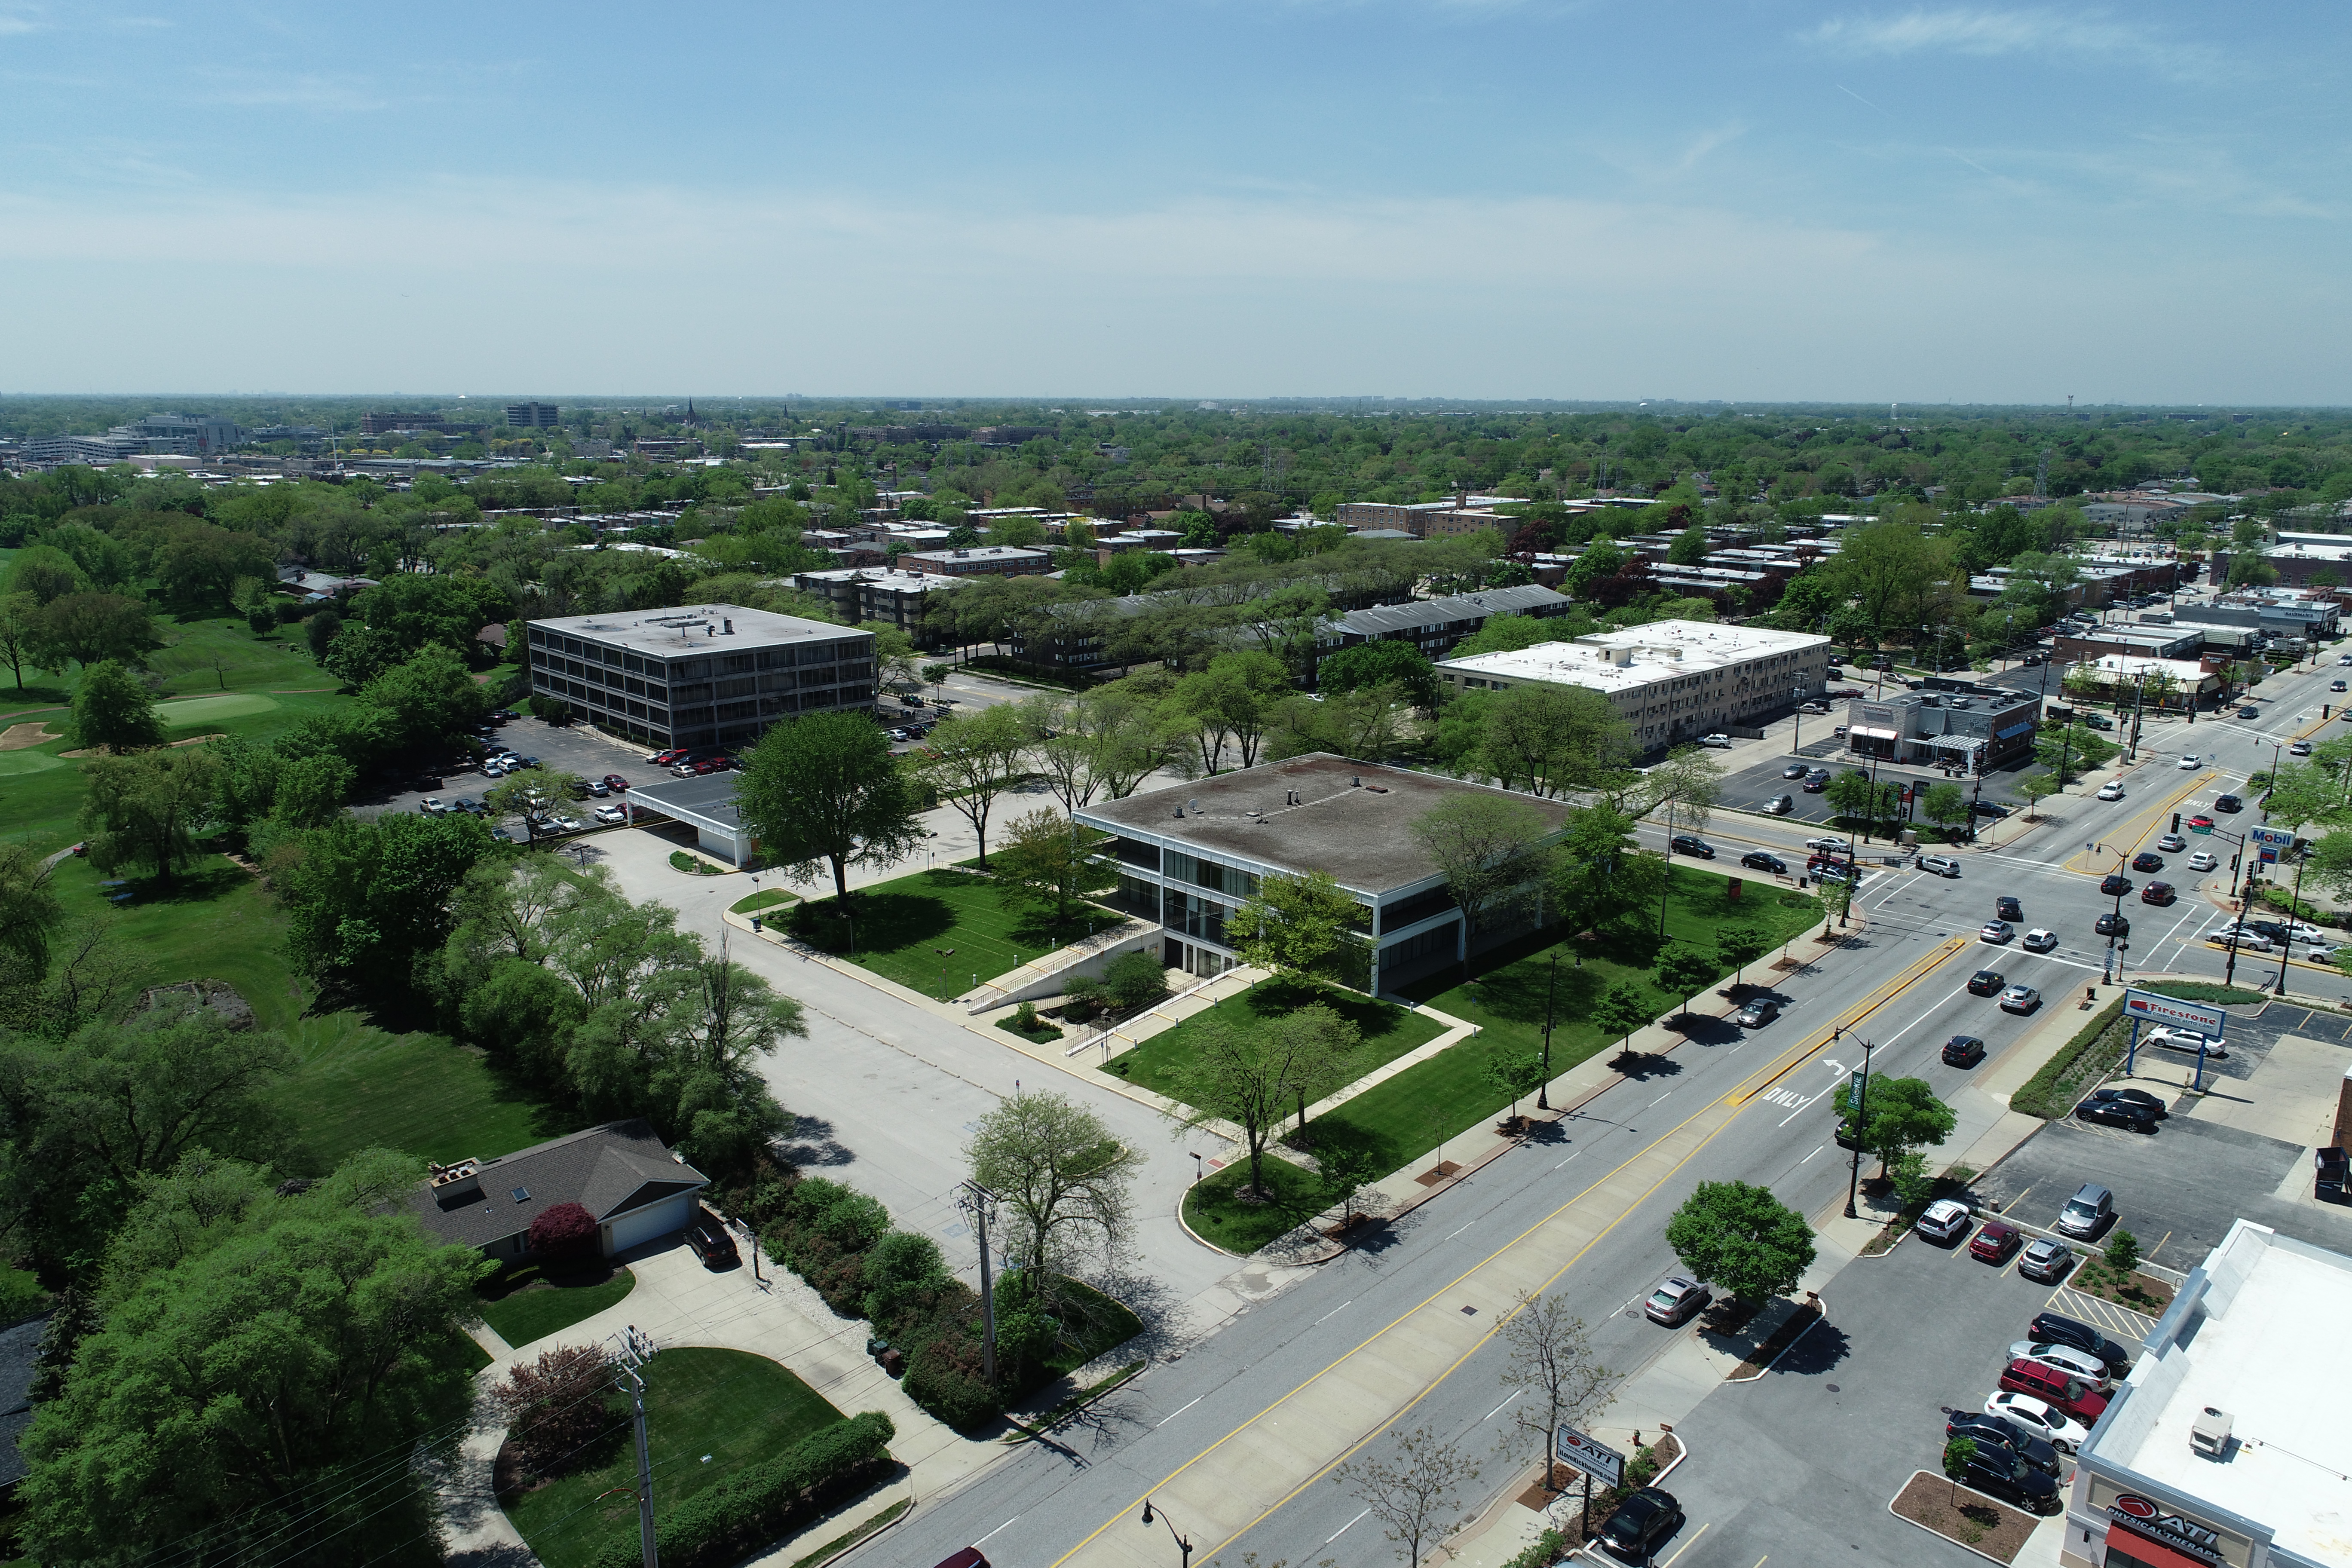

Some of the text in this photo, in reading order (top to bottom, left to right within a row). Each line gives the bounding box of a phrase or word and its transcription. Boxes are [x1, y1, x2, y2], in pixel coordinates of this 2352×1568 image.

[2183, 799, 2212, 808] ONLY
[2252, 830, 2291, 845] Mobil
[2150, 1003, 2216, 1025] Firestone
[2153, 1012, 2181, 1022] COMPLETE
[1762, 1087, 1811, 1109] ONLY
[1850, 1075, 1862, 1105] SKOKIE
[1566, 1443, 1609, 1468] PHYSICAL THERAPY
[1580, 1445, 1612, 1464] ATI
[1559, 1449, 1616, 1484] iLoveKickboxing.com
[2107, 1507, 2222, 1559] PHYSICAL THERAPY
[2158, 1516, 2218, 1544] ATI
